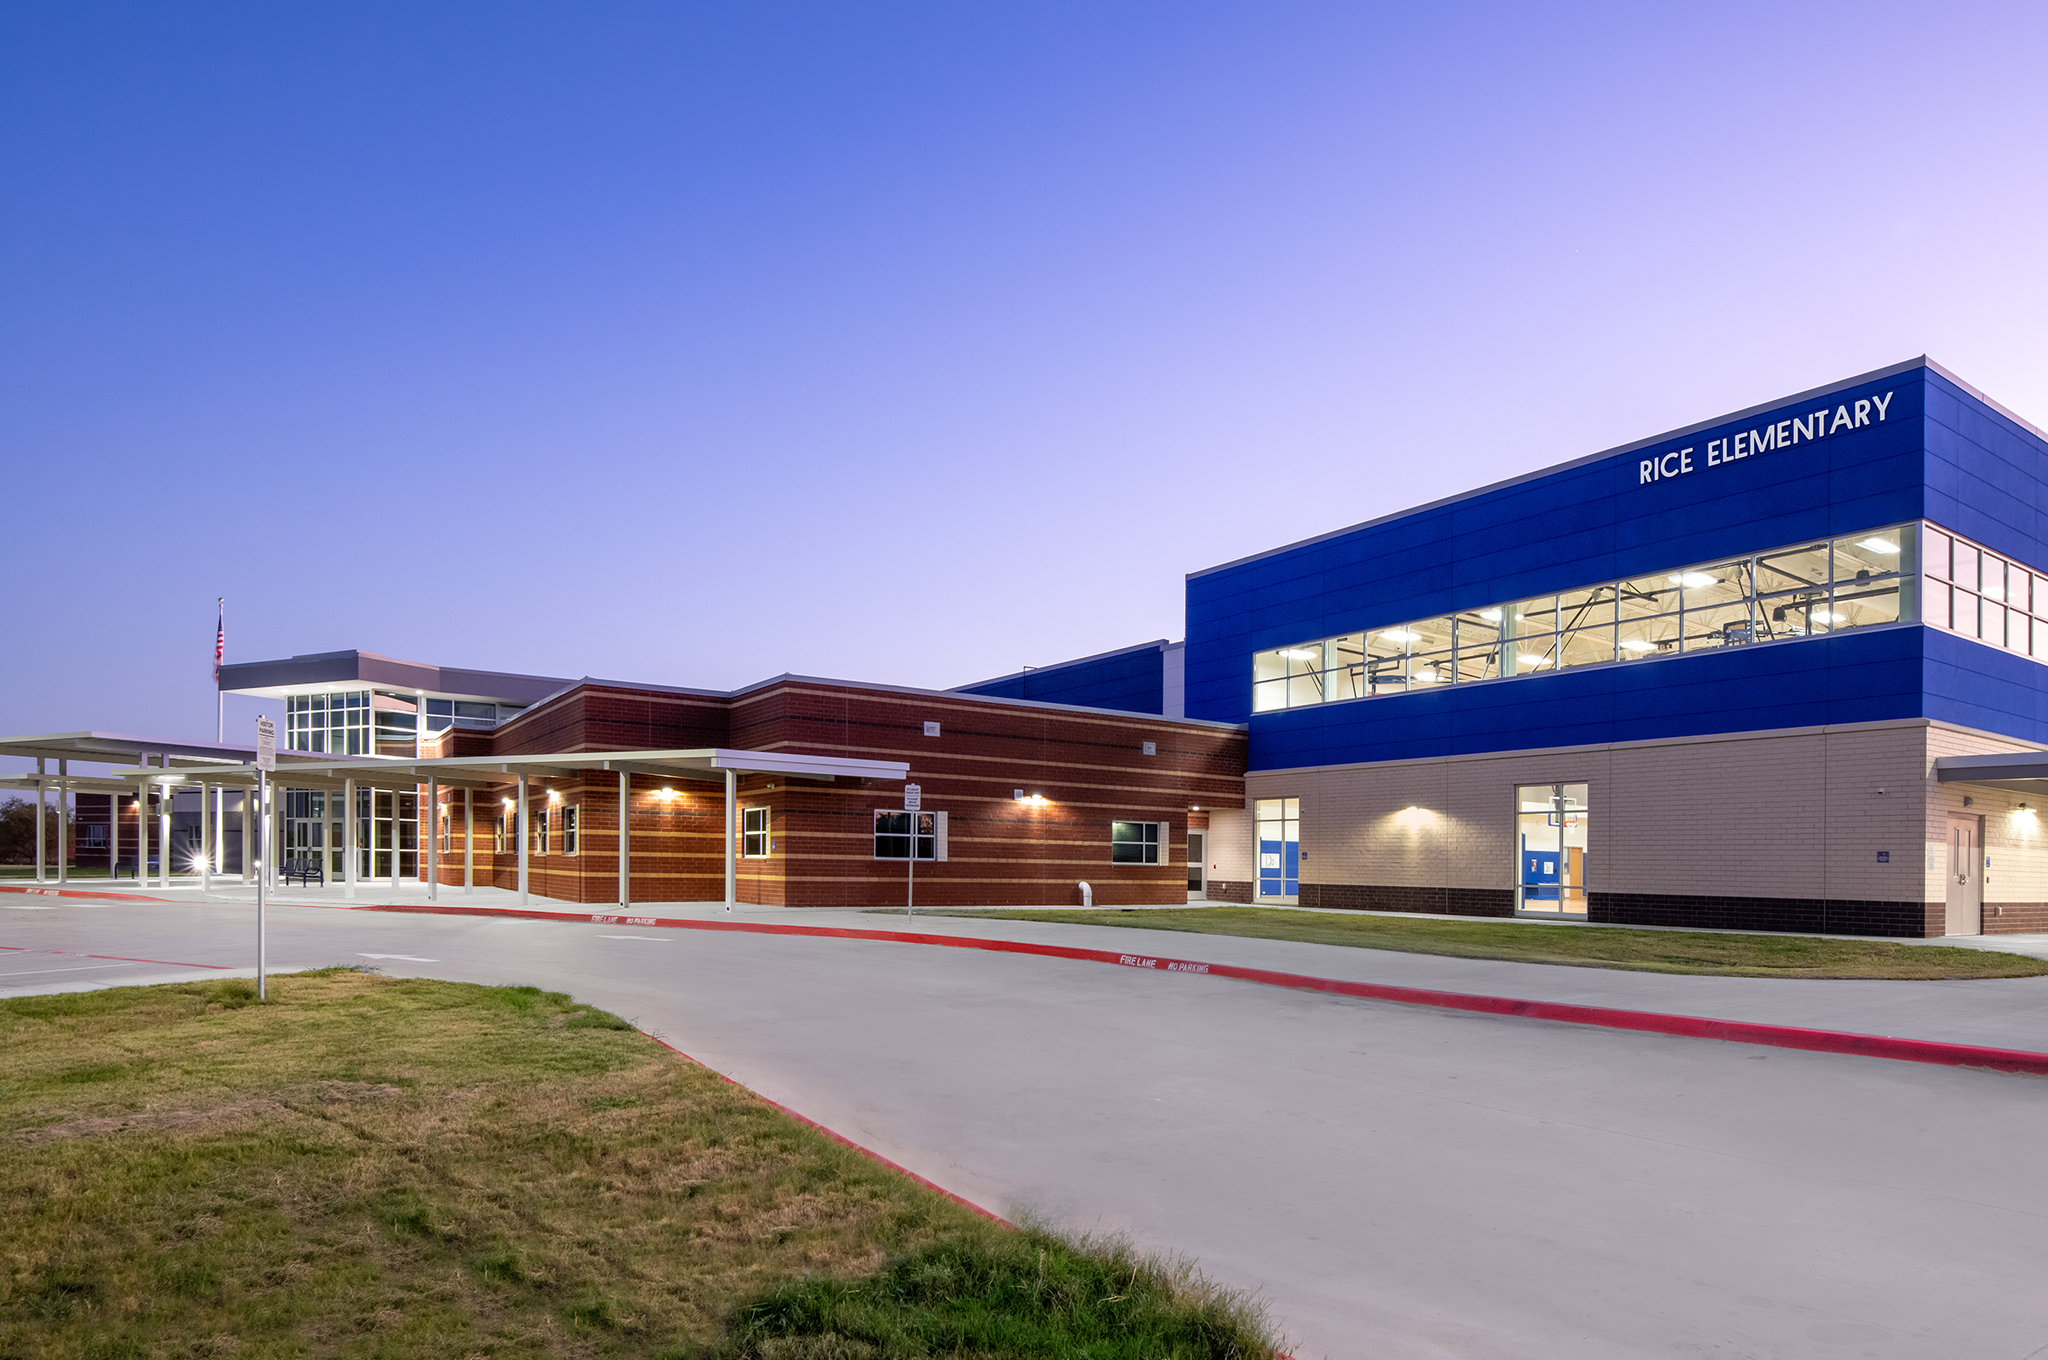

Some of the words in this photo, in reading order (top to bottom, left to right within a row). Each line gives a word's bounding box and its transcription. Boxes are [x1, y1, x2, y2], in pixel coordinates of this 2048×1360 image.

[1640, 447, 1693, 484] RICE
[1707, 391, 1894, 467] ELEMENTARY
[1120, 955, 1136, 965] FIRE
[1137, 957, 1156, 968] LANE
[1167, 962, 1178, 971] NO
[1179, 963, 1209, 973] PARKING
